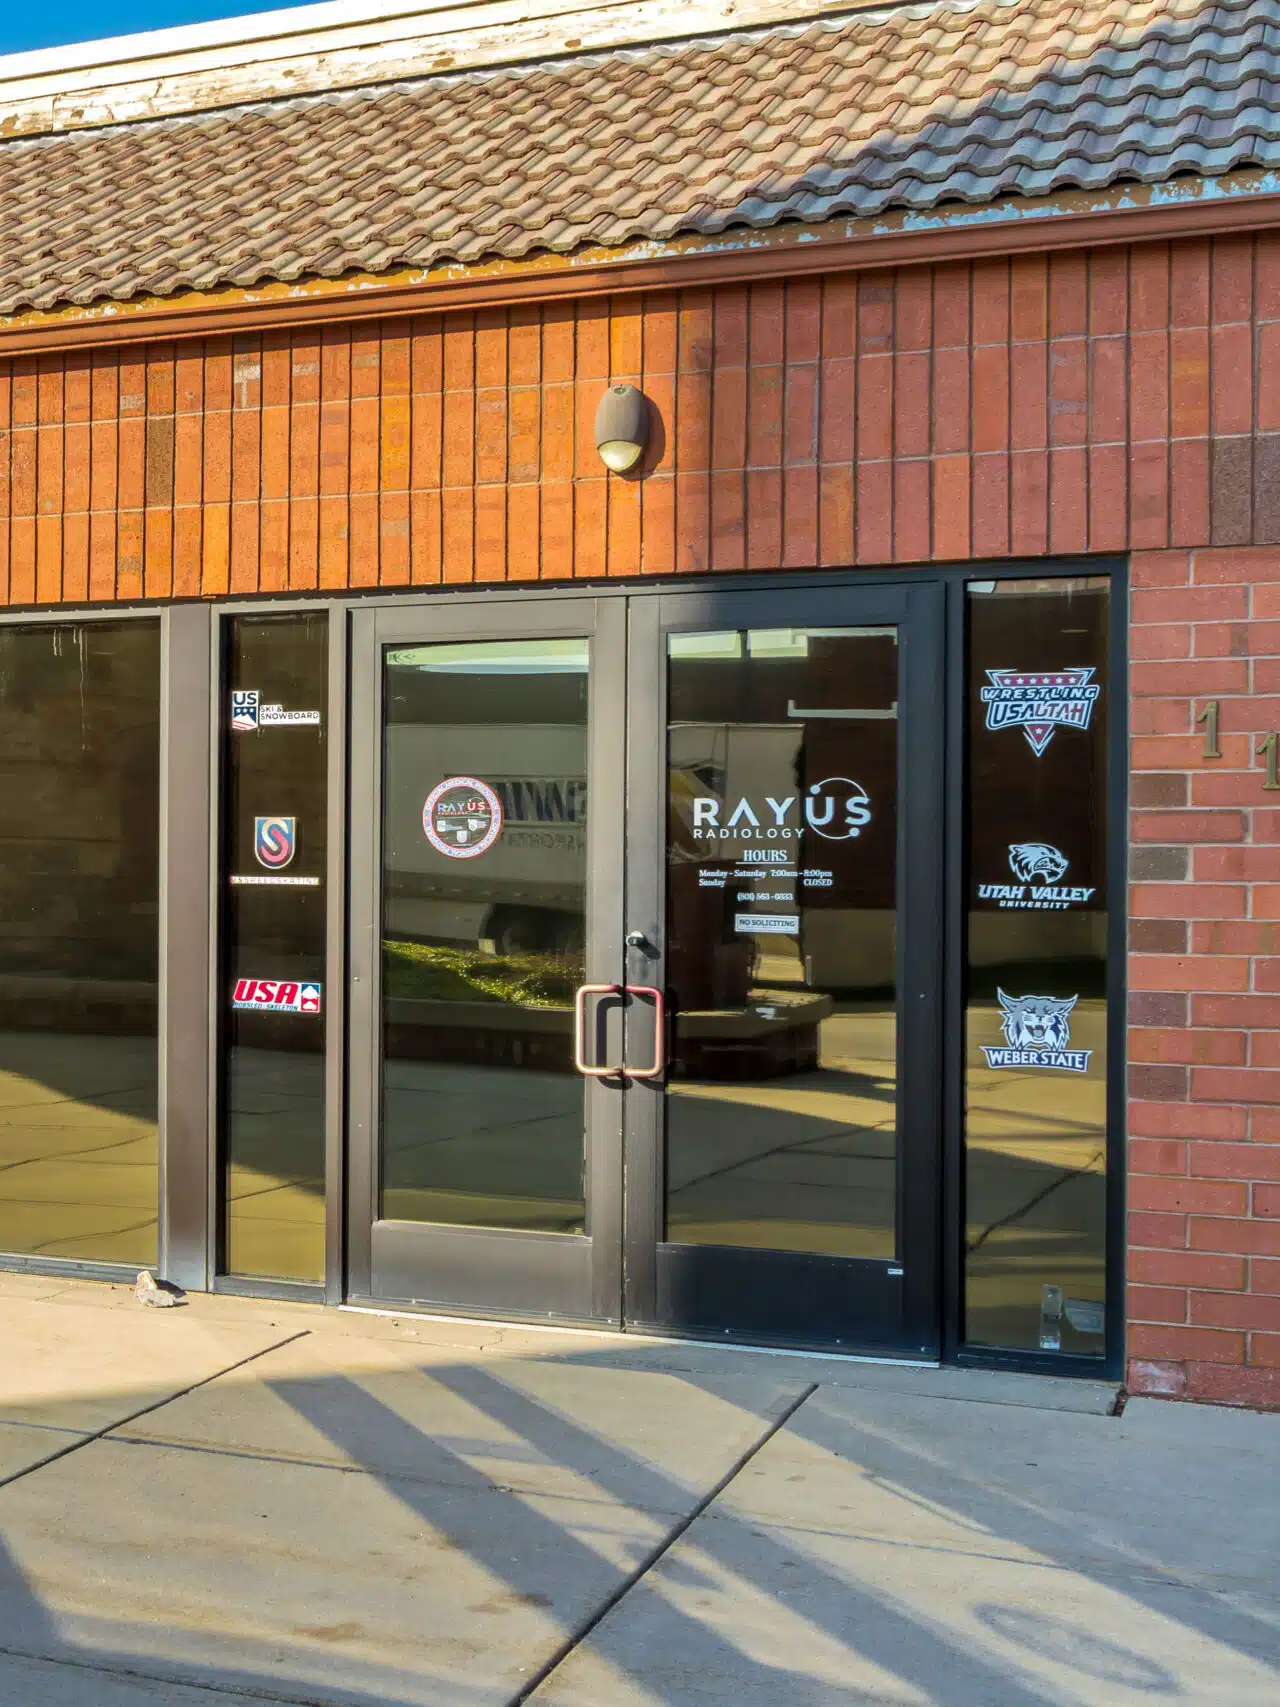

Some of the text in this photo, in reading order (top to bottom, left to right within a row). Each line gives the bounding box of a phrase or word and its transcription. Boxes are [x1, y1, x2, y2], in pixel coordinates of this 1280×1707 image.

[234, 692, 257, 705] US
[983, 686, 1097, 699] WRESTLING
[260, 712, 319, 720] SNOWBOARD
[438, 802, 485, 812] RAYUS
[693, 797, 871, 827] RAYUS
[693, 828, 805, 839] RADIOLOGY
[743, 849, 788, 862] HOURS
[699, 869, 728, 878] Monday
[734, 869, 766, 878] Saturday
[699, 878, 832, 888] Sunday CLOSED
[978, 885, 1096, 901] UTAH VALLEY
[999, 901, 1070, 909] UNIVERSITY
[752, 919, 795, 927] SOLICITING
[235, 980, 299, 1004] USA
[989, 1050, 1084, 1068] WEBER STATE
